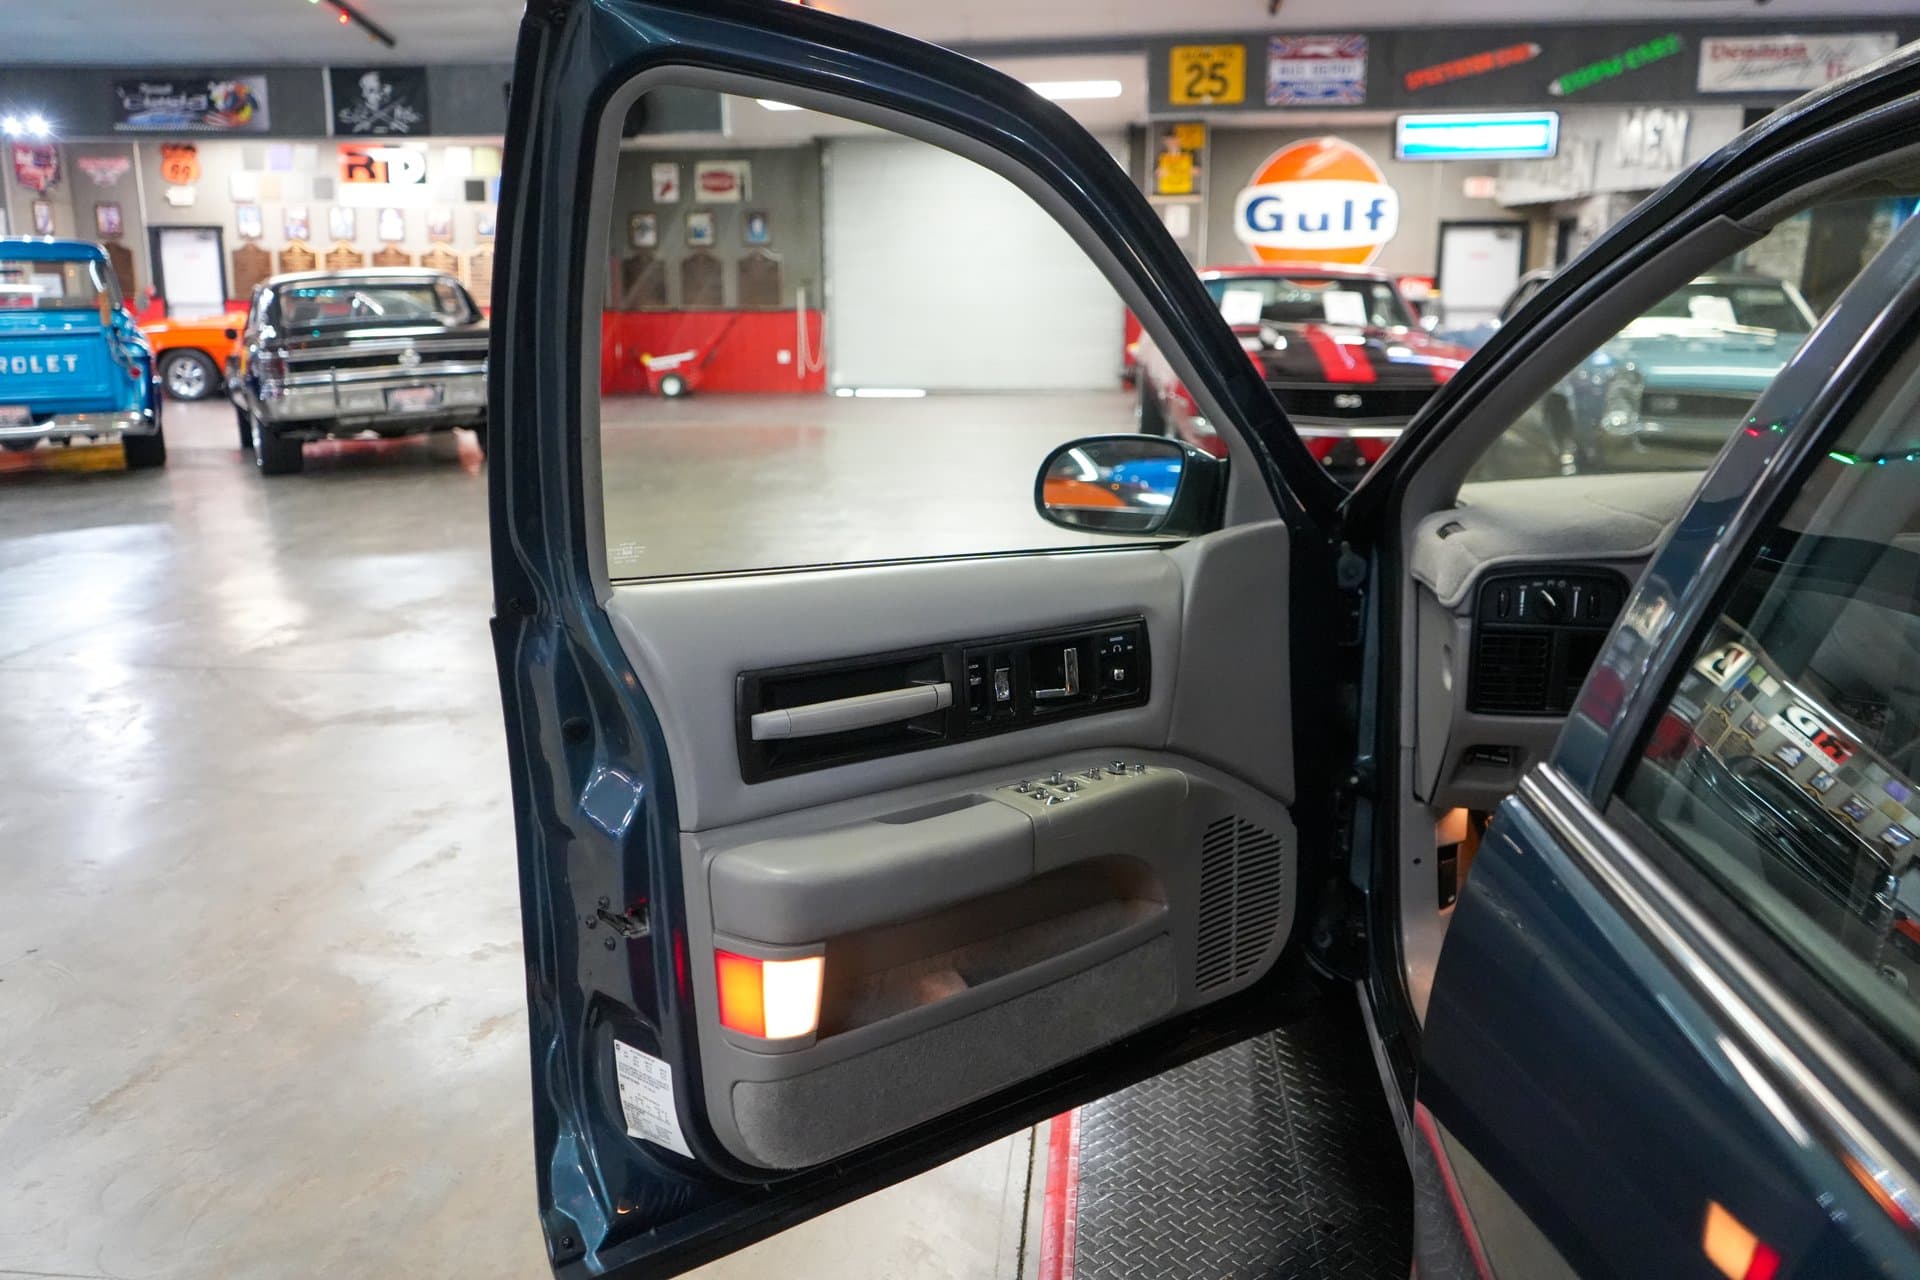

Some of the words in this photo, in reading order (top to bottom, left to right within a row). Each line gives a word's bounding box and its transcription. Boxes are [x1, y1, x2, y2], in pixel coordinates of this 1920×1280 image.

[1186, 62, 1229, 98] 25
[1614, 109, 1690, 168] MEN
[1246, 195, 1385, 232] Gulf
